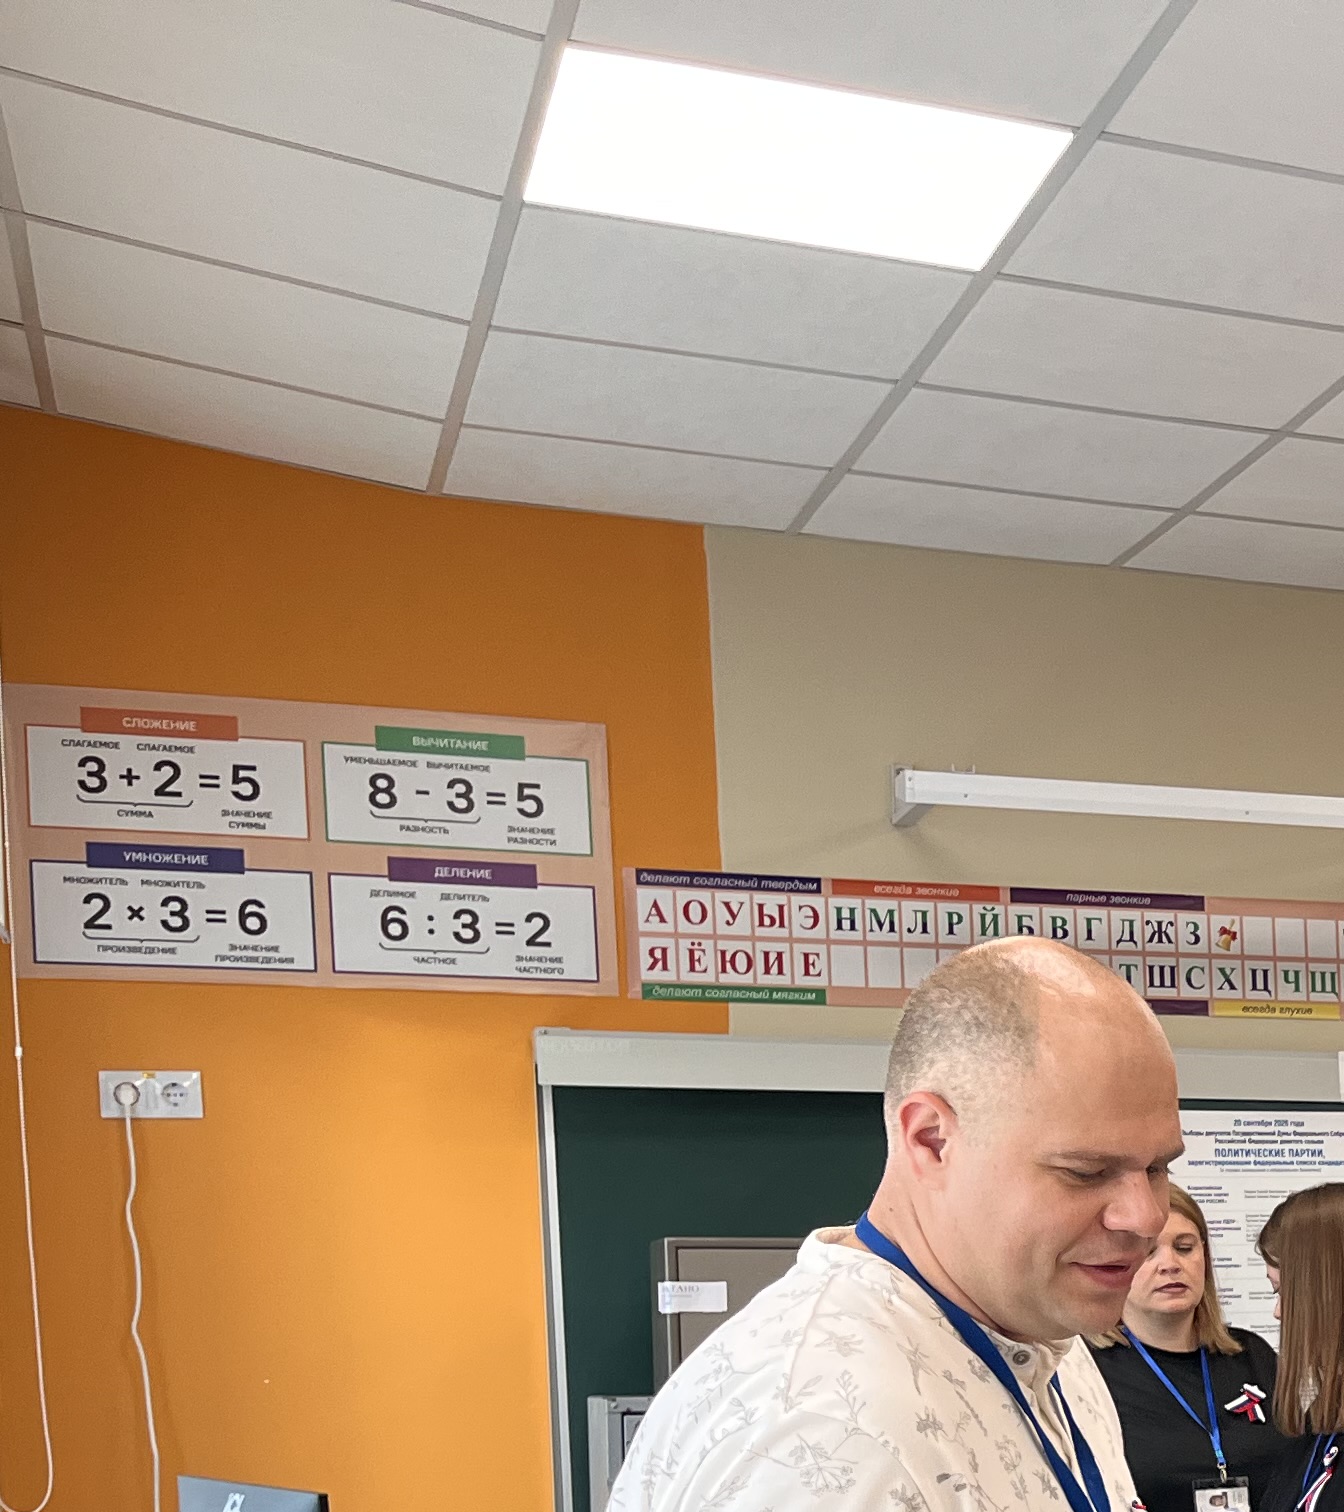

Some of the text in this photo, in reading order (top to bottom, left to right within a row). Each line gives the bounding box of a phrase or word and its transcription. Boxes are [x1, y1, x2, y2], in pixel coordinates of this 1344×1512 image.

[122, 717, 196, 731] СЛОЖЕНИЕ
[61, 739, 196, 754] СЛАГАЕМОЕ СЛАГАЕМОЕ
[412, 736, 488, 750] ВЫЧИТАНИЕ
[77, 756, 108, 793] 3
[153, 760, 182, 797] 2
[231, 765, 260, 801] 5
[369, 773, 397, 809] 8
[447, 777, 475, 814] 3
[517, 783, 544, 818] 5
[117, 810, 154, 818] СУММА
[124, 851, 208, 865] УМНОЖЕНИЕ
[435, 867, 492, 880] ДЕЛЕНИЕ
[640, 872, 817, 892] делают согласный твердым
[1066, 892, 1106, 906] парные
[82, 893, 112, 930] 2
[160, 895, 190, 933] 3
[238, 899, 267, 935] 6
[381, 905, 409, 941] 6
[452, 909, 481, 944] 3
[525, 912, 552, 947] 2
[644, 898, 668, 924] А
[682, 899, 708, 925] О
[715, 901, 744, 927] У
[757, 903, 786, 929] Ы
[799, 905, 820, 930] Э
[834, 906, 858, 932] Н
[866, 908, 897, 934] М
[907, 909, 931, 934] Л
[945, 911, 964, 936] Р
[980, 906, 1001, 937] Й
[1014, 914, 1035, 936] Б
[1050, 916, 1069, 940] В
[1084, 918, 1102, 941] Г
[1116, 919, 1138, 948] Д
[1145, 920, 1174, 944] Ж
[647, 941, 822, 977] Я Ё Ю И Е
[1118, 964, 1139, 987] Т
[1148, 965, 1178, 989] Ш
[1185, 966, 1205, 990] С
[1217, 968, 1238, 991] Х
[1250, 969, 1271, 993] Ц
[1281, 969, 1304, 992] Ч
[1309, 971, 1338, 996] Щ
[652, 986, 703, 999] делают
[705, 989, 769, 1001] согласный
[1215, 1149, 1325, 1159] ПОЛИТИЧЕСКИЕ ПАРТИИ,
